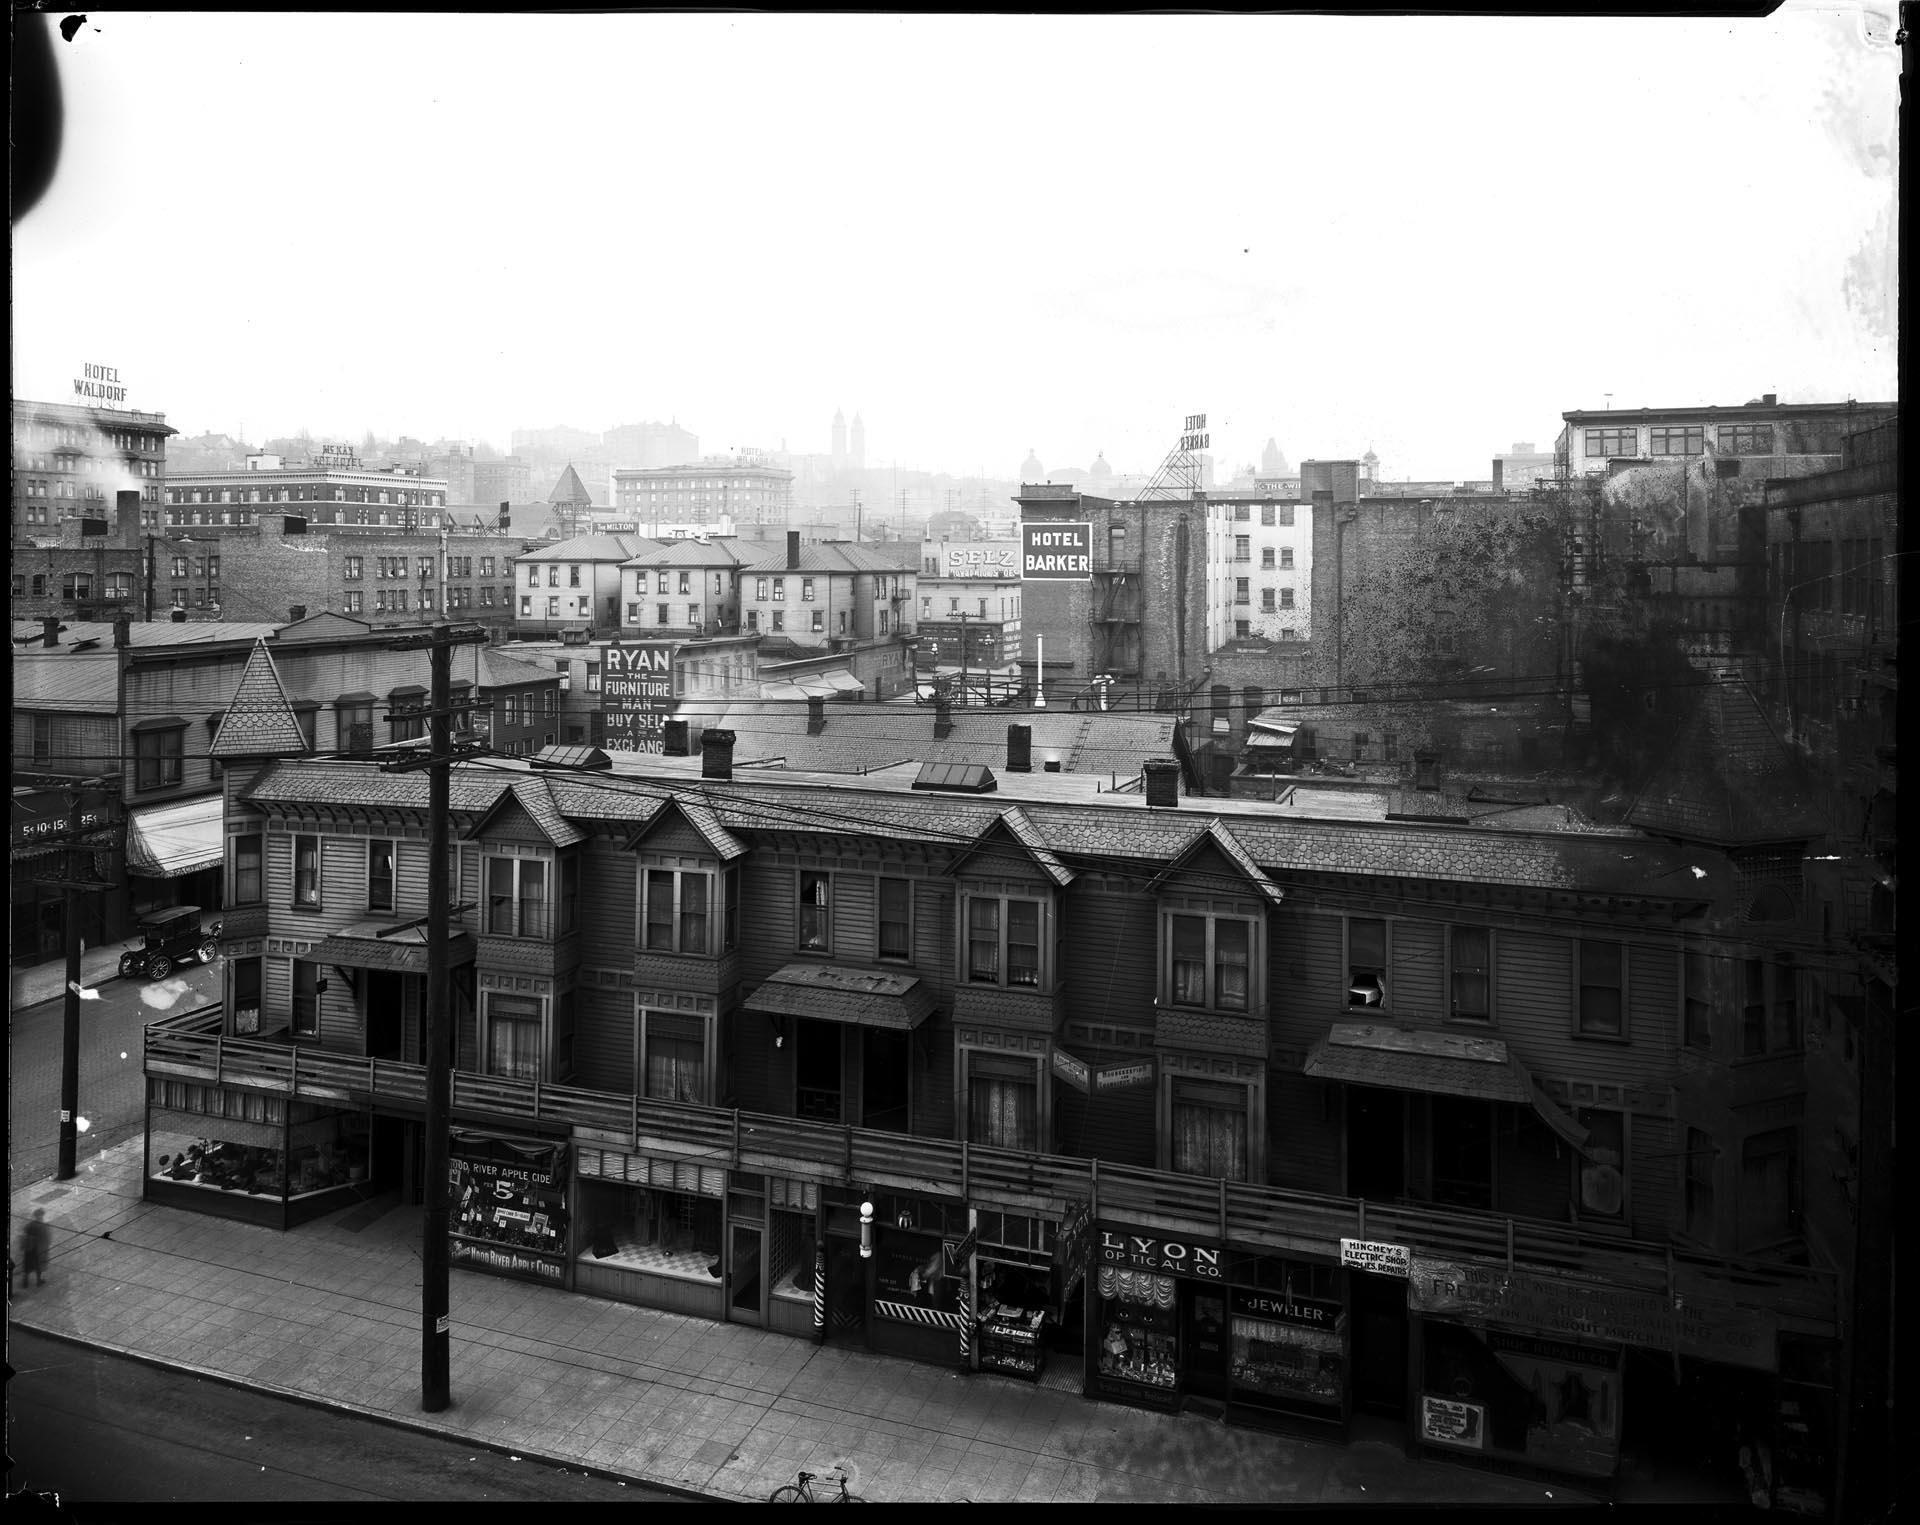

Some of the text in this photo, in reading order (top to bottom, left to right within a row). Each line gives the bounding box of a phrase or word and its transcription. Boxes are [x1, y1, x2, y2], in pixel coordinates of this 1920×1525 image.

[84, 362, 121, 383] HOTEL
[74, 379, 128, 402] WALDORF
[606, 523, 635, 531] MILTON
[1031, 532, 1083, 547] HOTEL
[949, 549, 1017, 568] SELZ
[1025, 554, 1089, 572] BARKER
[606, 649, 669, 671] RYAN
[627, 672, 648, 680] THE
[605, 681, 671, 697] FURNITURE
[622, 698, 652, 711] MAN
[607, 714, 664, 729] BUY SEL
[606, 738, 664, 754] EXCHANG
[473, 1163, 499, 1176] RIVER
[501, 1168, 529, 1181] APPLE
[531, 1172, 551, 1185] CIDE
[1101, 1231, 1221, 1266] LYON
[1344, 1250, 1394, 1263] ELECTRIC
[1349, 1241, 1402, 1256] HINCHEY'S
[471, 1246, 491, 1265] HOOD
[490, 1250, 512, 1269] RIVER
[511, 1253, 537, 1272] APPLE
[536, 1259, 562, 1279] CIDER
[1104, 1249, 1223, 1278] OPTICAL CO.
[1377, 1263, 1407, 1276] REPAIRS
[1463, 1269, 1489, 1285] THIS
[1495, 1274, 1525, 1291] PLACE
[1682, 1306, 1704, 1321] THE
[1248, 1298, 1323, 1321] JEWELER
[1550, 1317, 1600, 1336] ABOUT
[1605, 1326, 1655, 1345] MARCH
